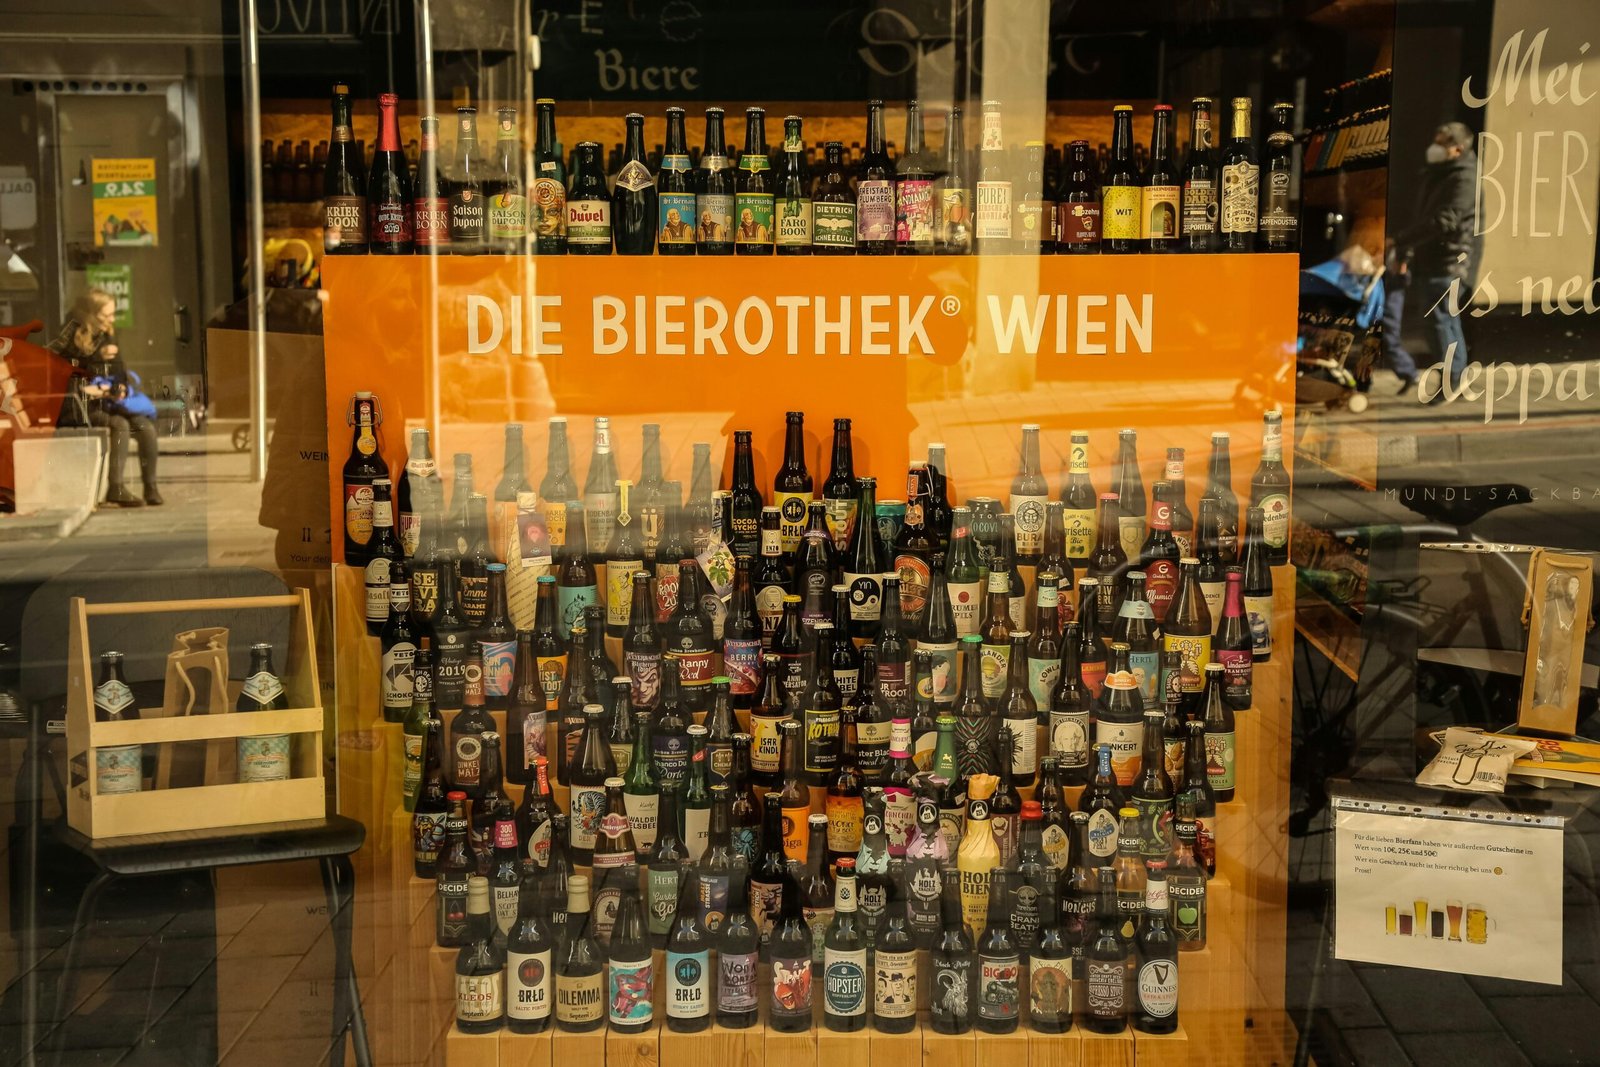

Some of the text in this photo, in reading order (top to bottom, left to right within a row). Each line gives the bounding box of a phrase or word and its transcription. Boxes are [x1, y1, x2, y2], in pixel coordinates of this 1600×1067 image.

[1473, 130, 1594, 238] BIER
[1184, 196, 1217, 204] DARK
[327, 206, 359, 217] KRIEK
[416, 211, 447, 220] KRIEK
[453, 205, 483, 216] Saison
[570, 208, 604, 223] Duvel
[816, 206, 853, 215] DIETRICH
[1115, 208, 1133, 216] WIT
[328, 217, 358, 228] BOON
[416, 220, 447, 230] BOON
[453, 216, 483, 229] Dupont
[780, 218, 806, 228] FARO
[780, 227, 807, 236] BOON
[1424, 252, 1501, 317] is
[466, 294, 563, 354] DIE
[986, 294, 1153, 354] WIEN
[836, 499, 848, 551] STOUT
[1017, 533, 1044, 541] BURA
[439, 666, 465, 676] 2019
[760, 738, 777, 746] ISAR
[1111, 743, 1137, 751] NKERT
[759, 745, 779, 754] KINDL
[500, 824, 513, 833] 300
[1376, 835, 1394, 843] lieben
[1395, 837, 1422, 846] Bierfans
[1423, 840, 1441, 848] haben
[1454, 843, 1485, 851] außerdem
[1486, 844, 1524, 854] Gutscheine
[1379, 858, 1408, 866] Geschenk
[1448, 864, 1469, 873] richtig
[918, 880, 936, 888] HOLZ
[1170, 886, 1205, 895] DECIDER
[864, 895, 881, 903] HOLZ
[984, 967, 1000, 978] BIG
[828, 977, 862, 993] HOPSTER
[458, 993, 491, 1001] KLEOS
[559, 987, 601, 1006] DILEMMA
